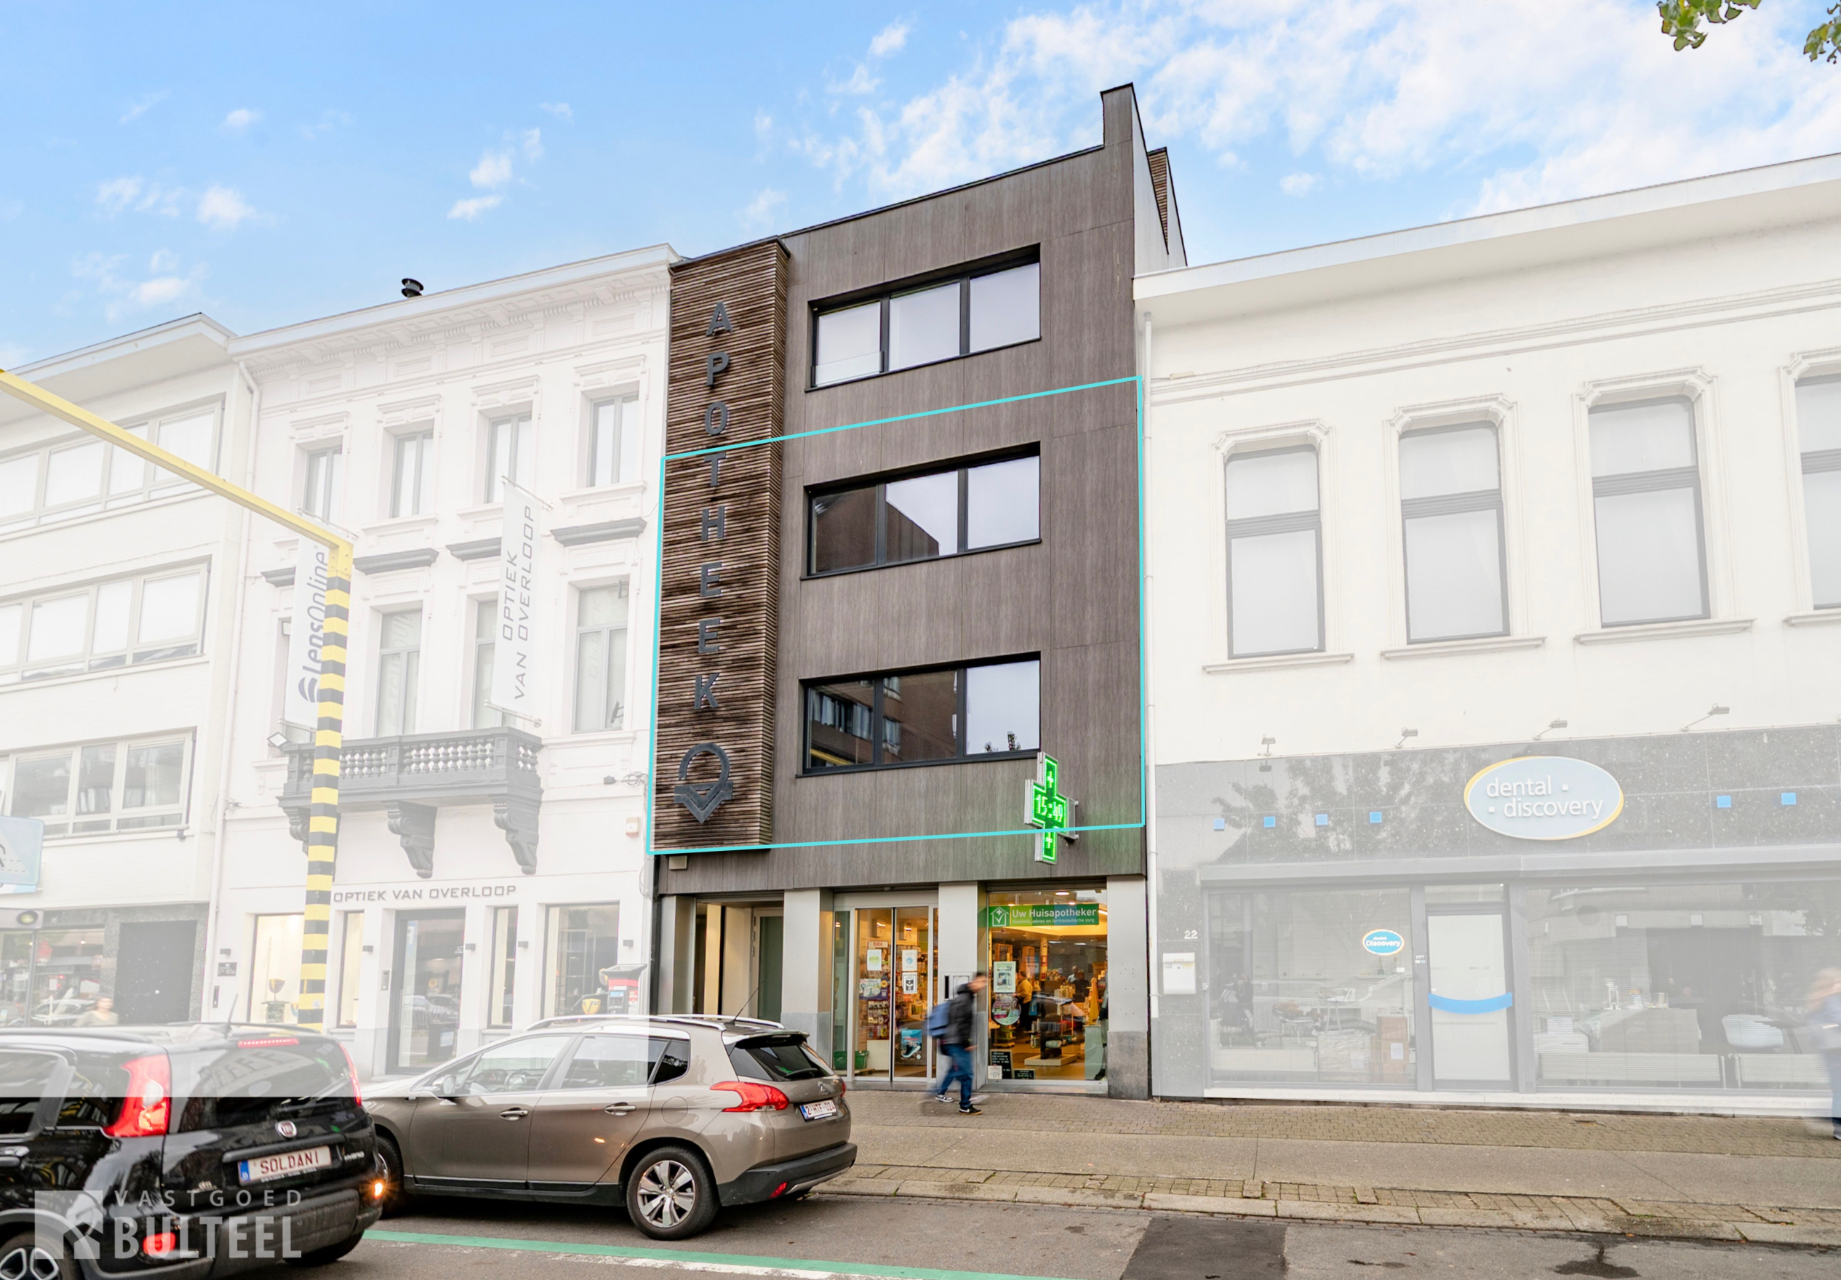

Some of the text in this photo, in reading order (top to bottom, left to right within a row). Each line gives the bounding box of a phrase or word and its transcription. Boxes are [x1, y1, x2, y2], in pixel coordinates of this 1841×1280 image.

[694, 301, 733, 709] APOTHEEK
[502, 550, 518, 642] OPTIEK
[514, 505, 535, 700] VAN OVERLOOP
[1486, 775, 1553, 797] dental
[1503, 797, 1604, 819] discovery
[333, 885, 517, 903] OPTIEK VAN OVERLOOP
[1012, 908, 1097, 918] Uw Huisapotheker
[1184, 929, 1198, 940] 22
[260, 1150, 319, 1175] SOLDANI
